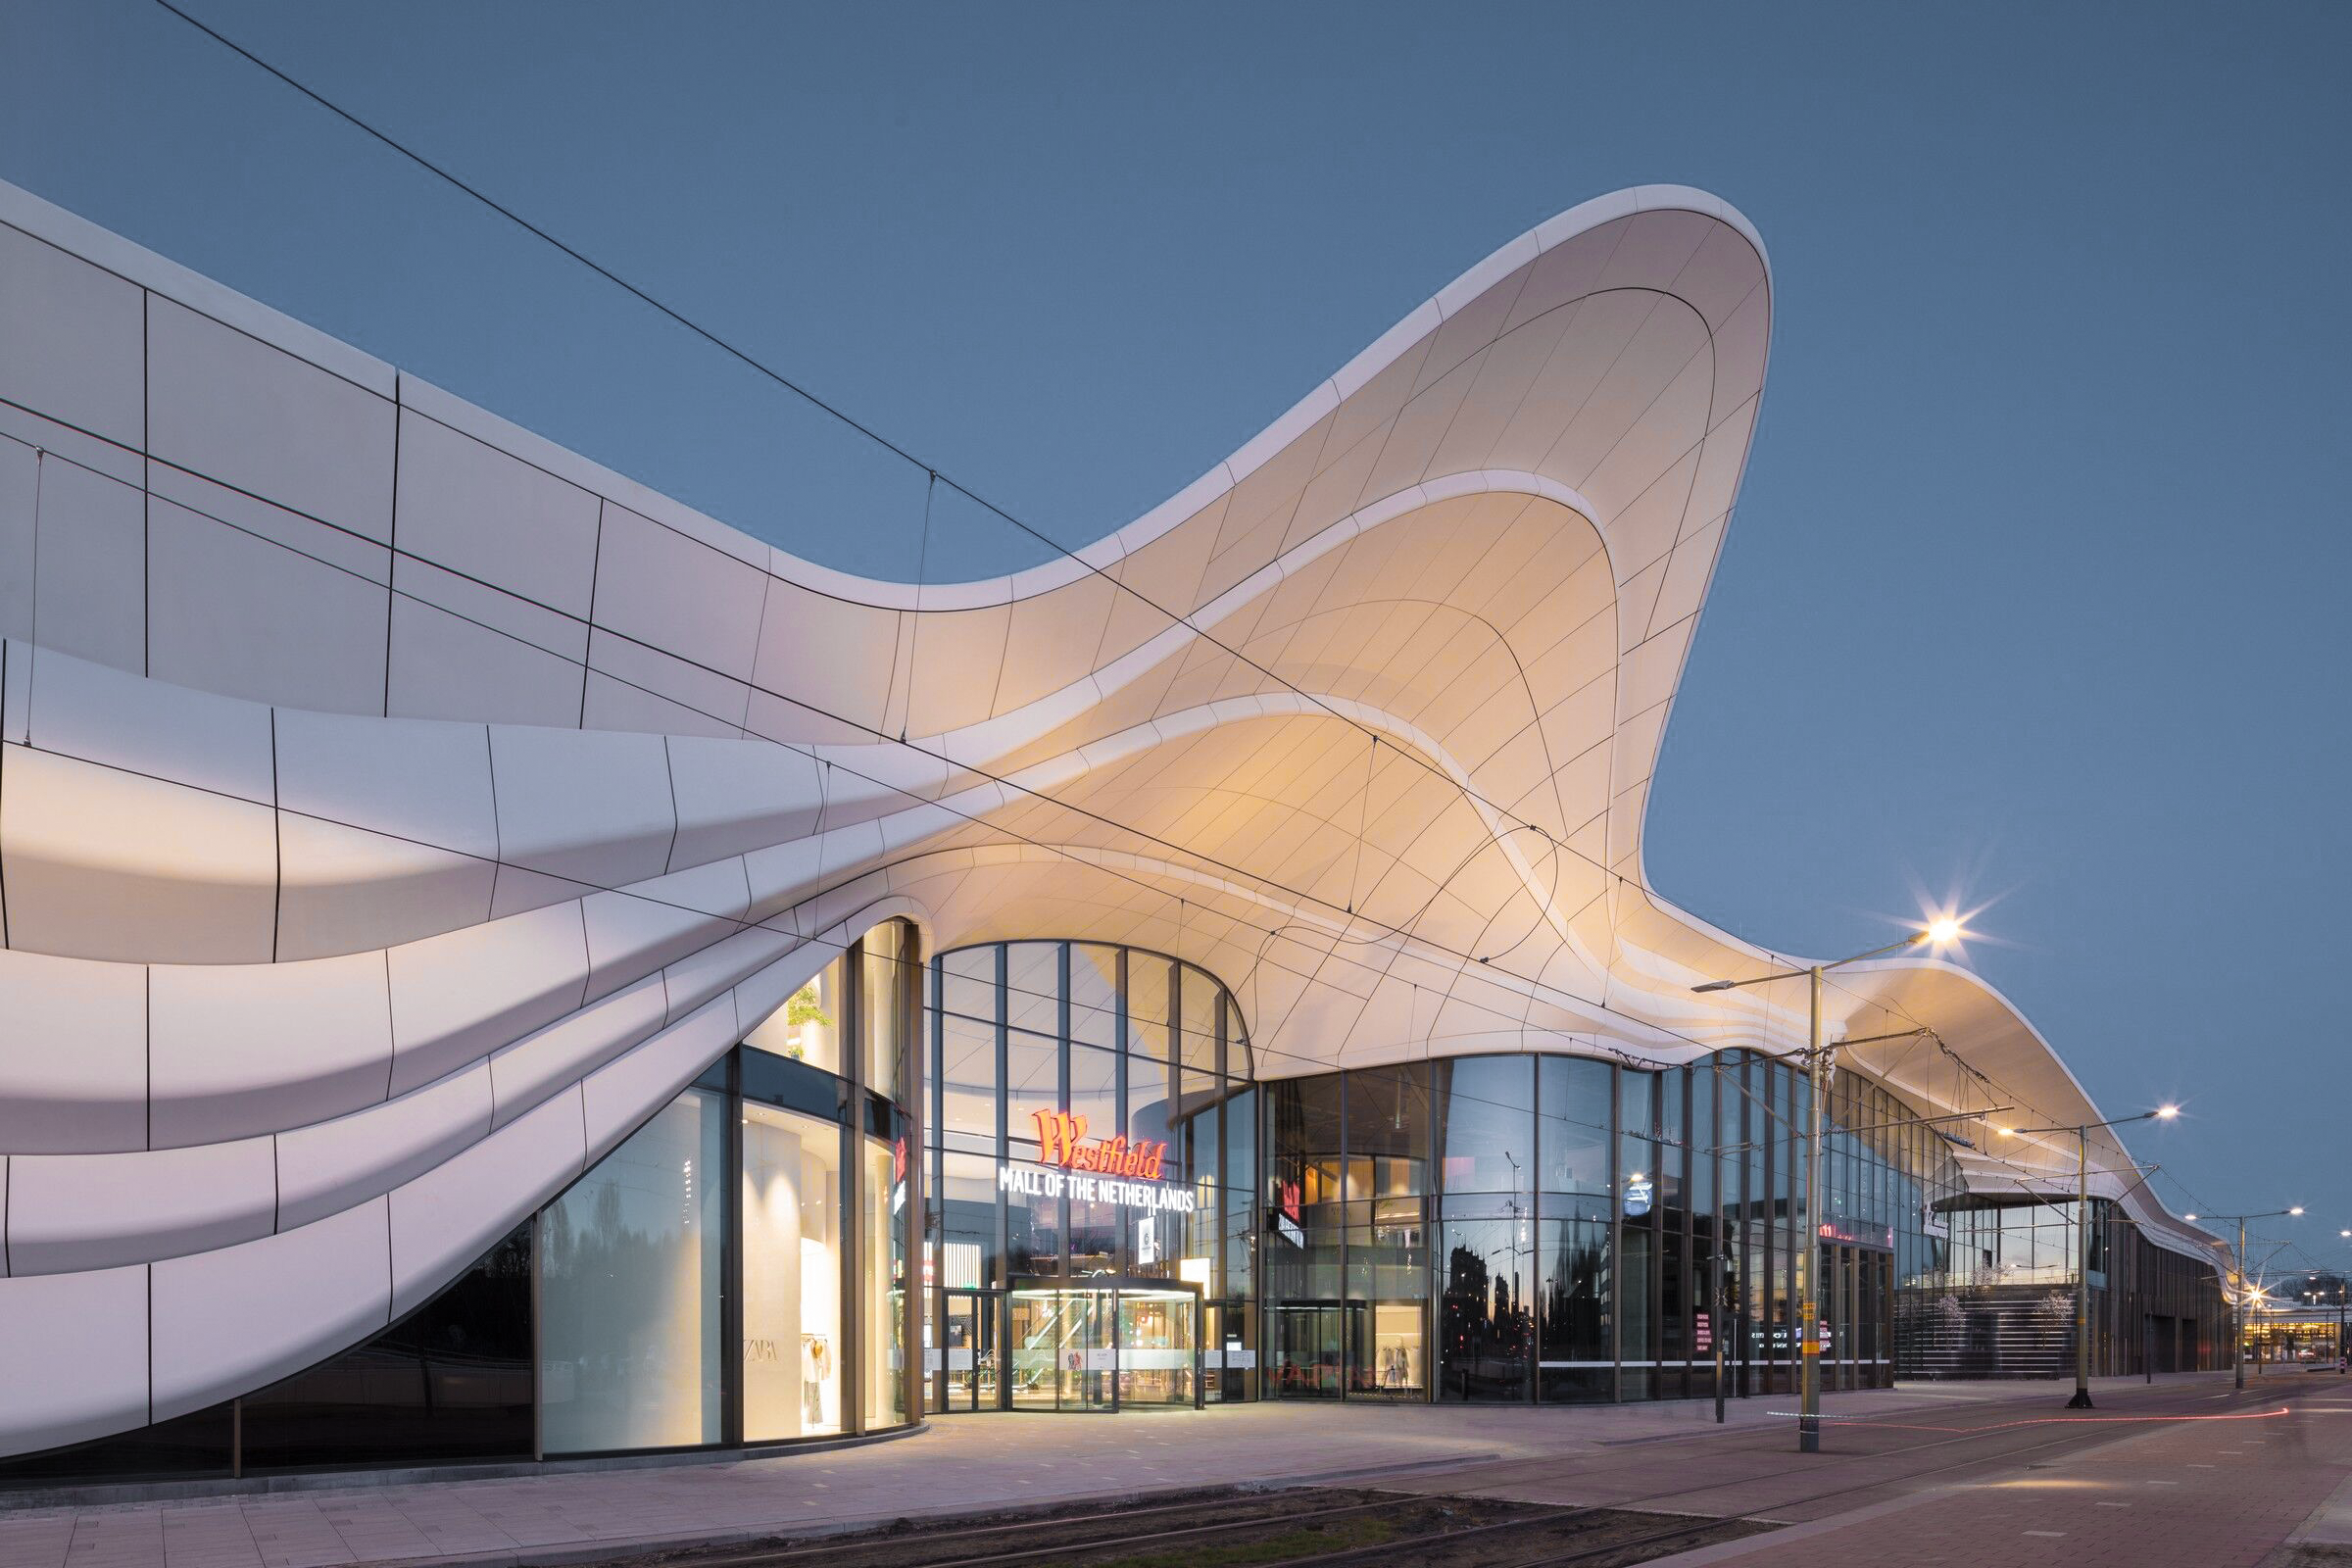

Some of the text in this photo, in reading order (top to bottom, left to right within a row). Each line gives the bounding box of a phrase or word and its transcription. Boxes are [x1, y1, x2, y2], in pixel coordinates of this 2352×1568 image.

[1032, 1108, 1167, 1179] Westfield
[1000, 1167, 1194, 1213] MALL OF THE NETHERLANDS
[744, 1339, 777, 1362] ZARA
